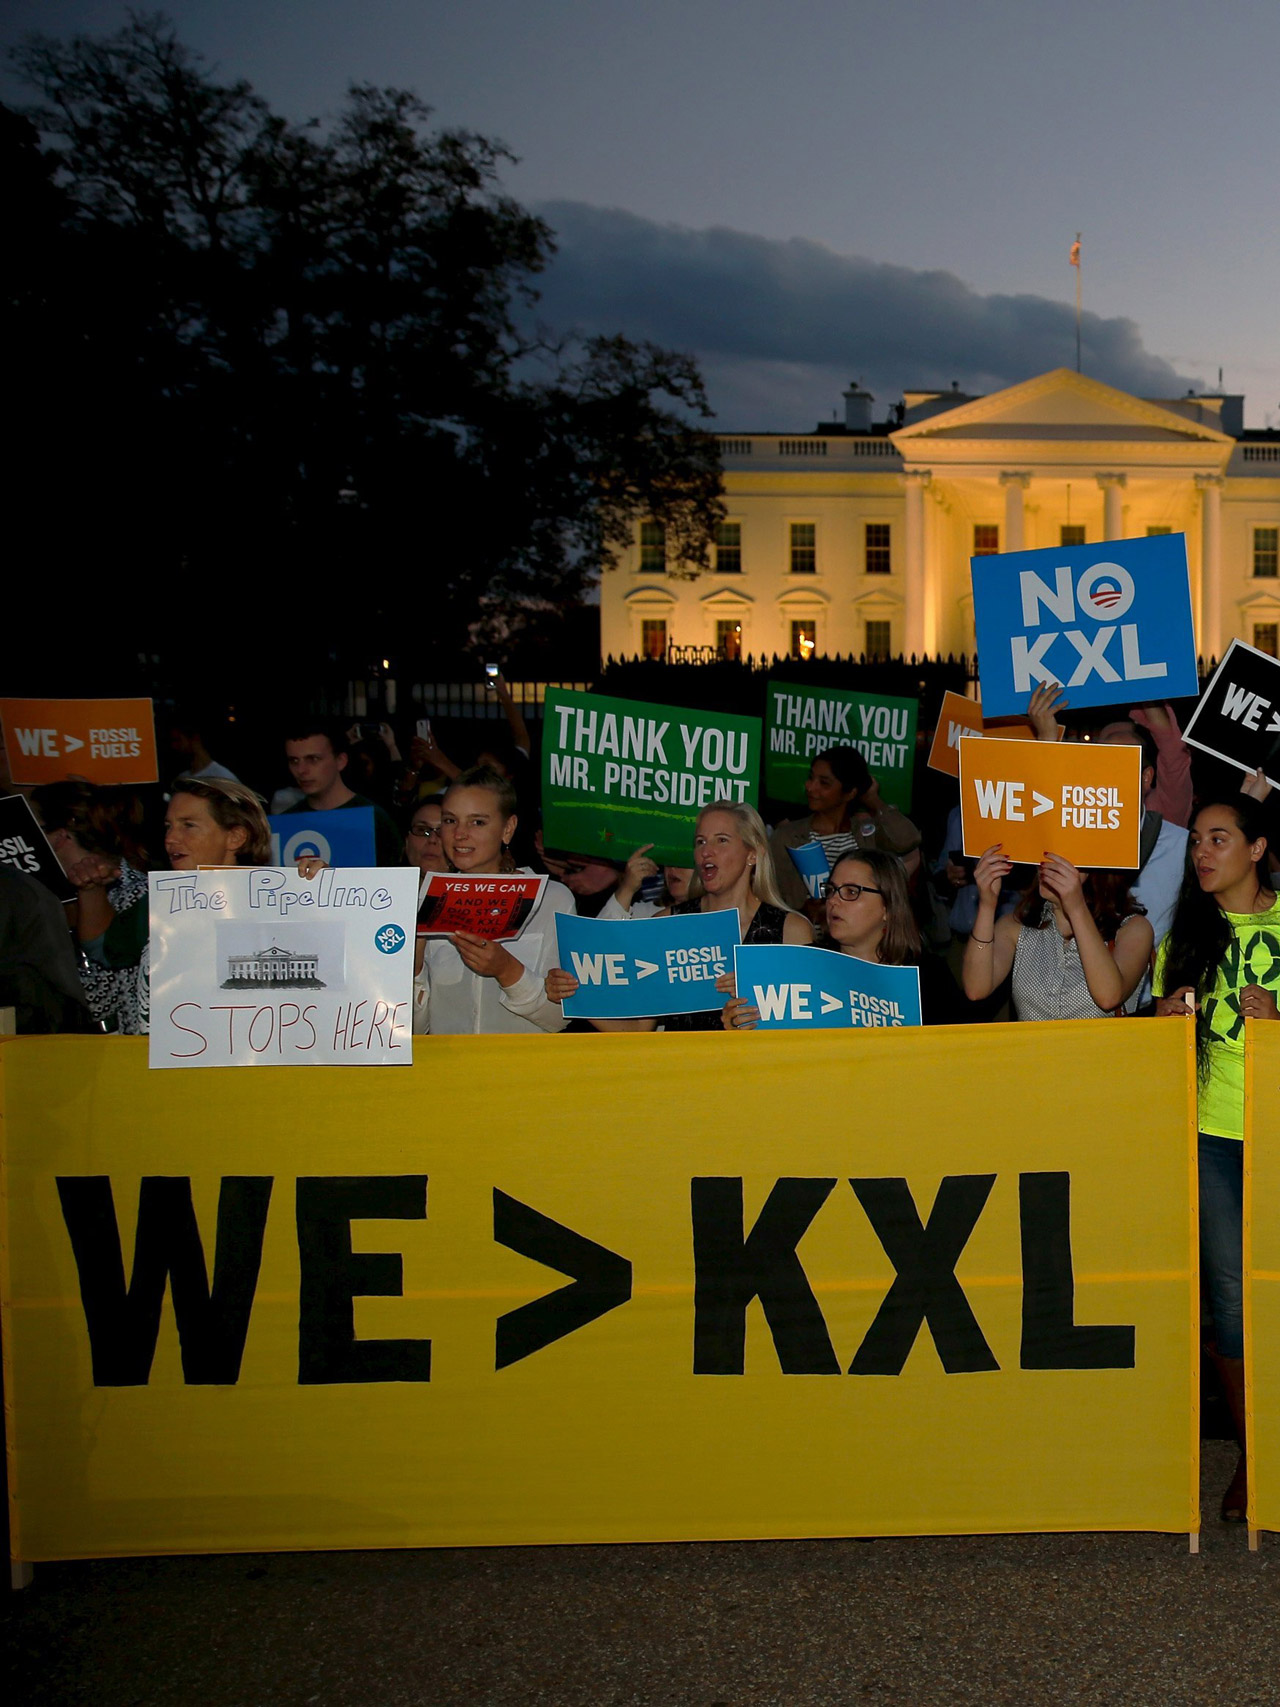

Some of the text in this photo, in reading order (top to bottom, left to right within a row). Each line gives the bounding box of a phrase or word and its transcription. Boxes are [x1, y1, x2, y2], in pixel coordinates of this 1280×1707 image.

[1019, 562, 1135, 627] NO
[1011, 623, 1168, 693] KXL
[773, 692, 908, 741] THANK YOU
[1220, 682, 1272, 732] WE
[14, 728, 60, 757] WE
[89, 728, 142, 743] FOSSIL
[555, 705, 748, 774] THANK YOU
[770, 727, 800, 755] MR.
[947, 720, 983, 750] W
[91, 743, 141, 759] FUELS
[549, 753, 750, 807] MR. PRESIDENT
[974, 779, 1025, 822] WE
[1062, 785, 1123, 808] FOSSIL
[1061, 807, 1120, 830] FUELS
[158, 869, 393, 915] The Pipeline
[445, 882, 527, 893] YES WE CAN
[454, 898, 508, 907] AND WE
[377, 927, 395, 944] NO
[381, 933, 405, 952] KXL
[570, 951, 630, 986] WE
[665, 946, 727, 966] FOSSIL
[668, 962, 726, 983] FUELS
[753, 984, 812, 1021] WE
[849, 990, 905, 1020] FOSSIL
[170, 1000, 409, 1057] STOPS HERE
[55, 1174, 432, 1387] WE
[691, 1171, 1135, 1376] KXL
